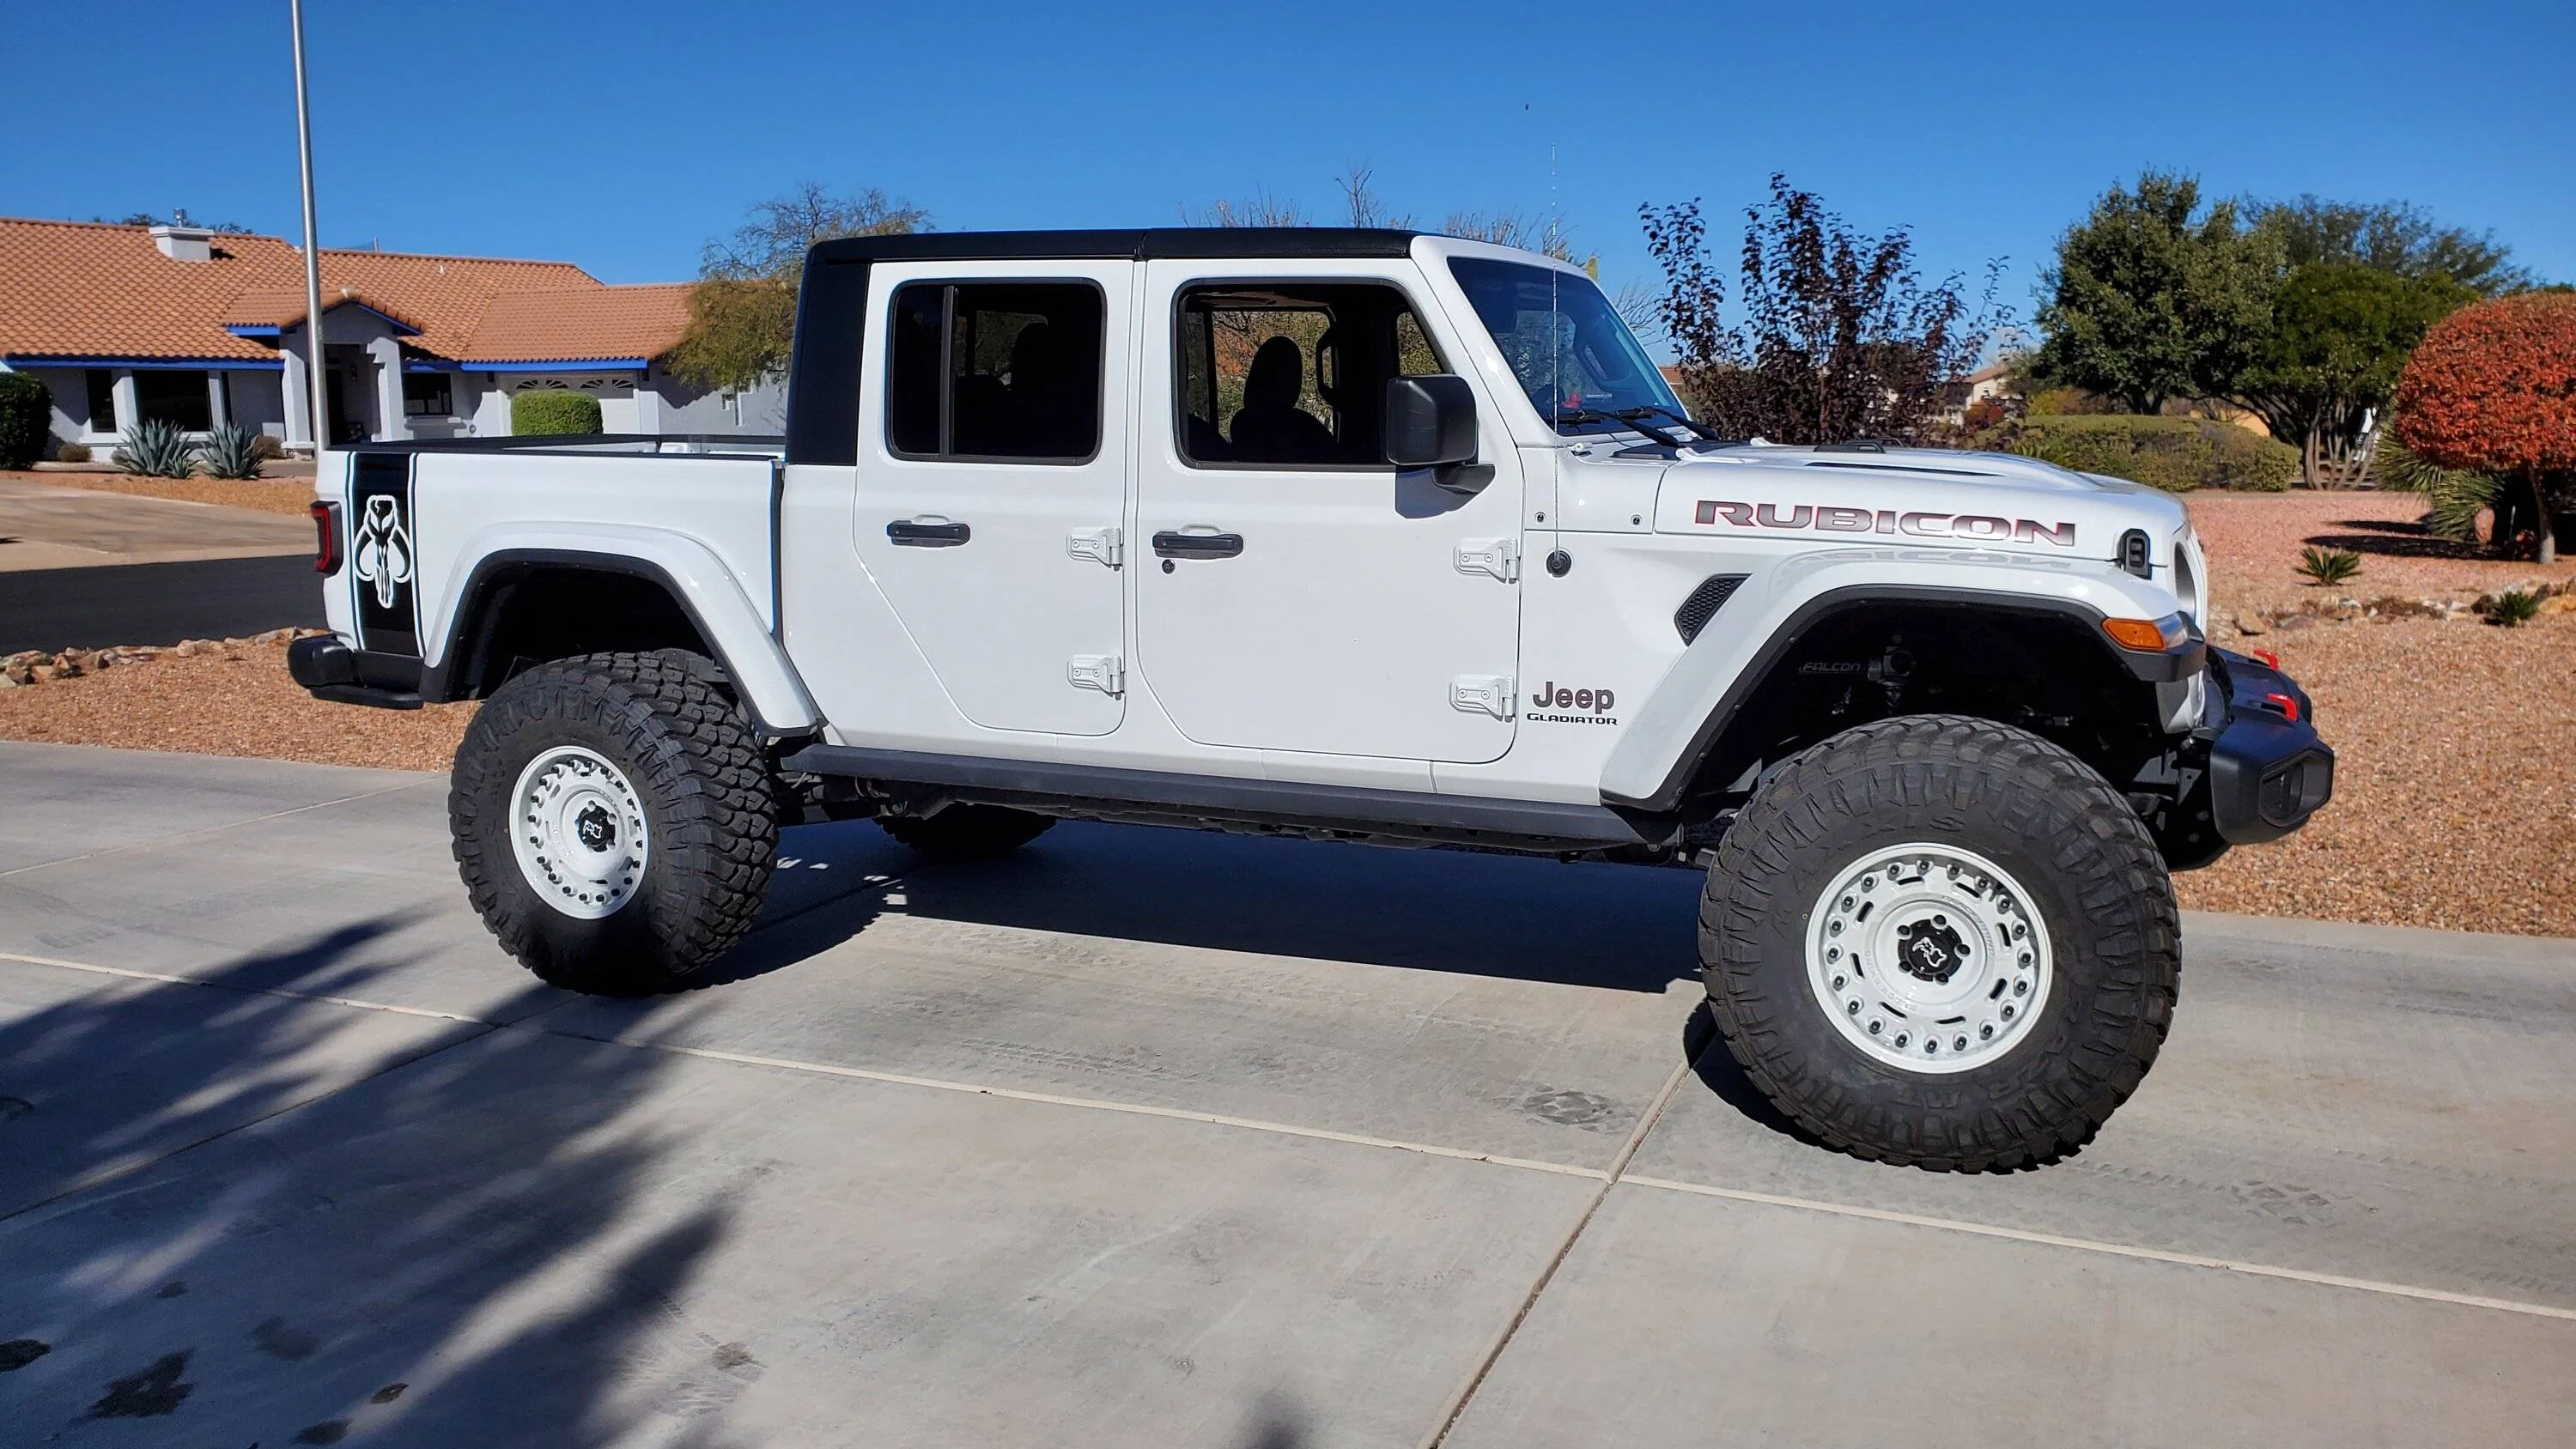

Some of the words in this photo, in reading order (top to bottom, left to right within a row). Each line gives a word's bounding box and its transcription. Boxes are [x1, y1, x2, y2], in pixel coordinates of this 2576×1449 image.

[1693, 500, 2076, 547] RUBICON
[1801, 662, 1862, 672] FALCON
[1532, 681, 1615, 714] Jeep
[1526, 712, 1619, 726] GLADIATOR
